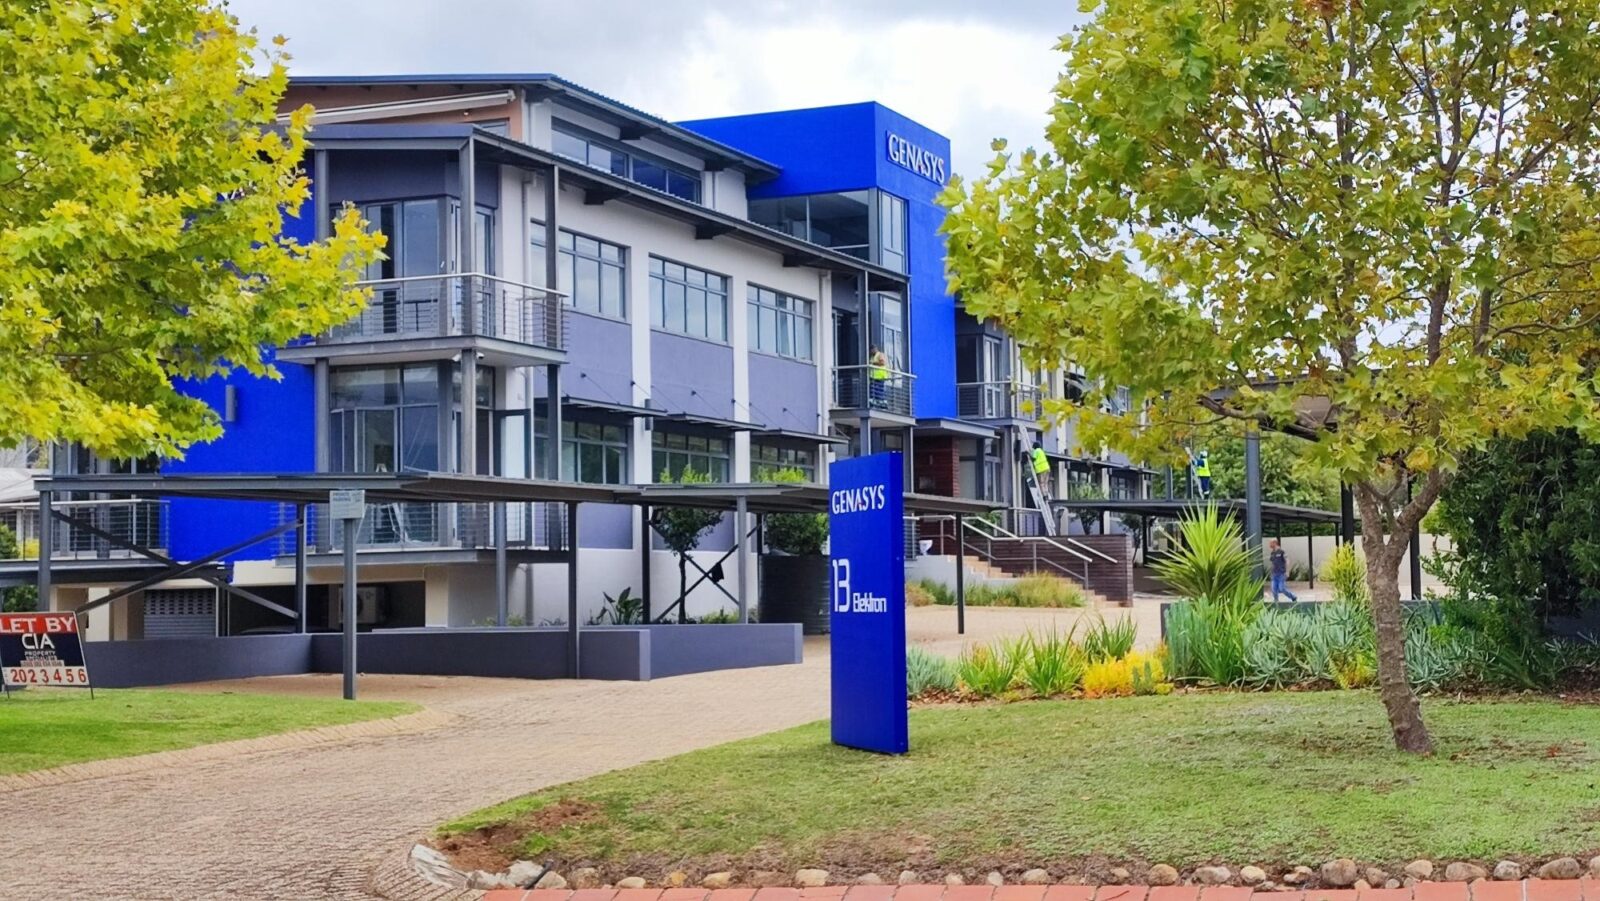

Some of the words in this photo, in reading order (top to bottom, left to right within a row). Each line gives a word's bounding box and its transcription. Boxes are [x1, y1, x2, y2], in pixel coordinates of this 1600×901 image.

[888, 133, 945, 184] GENASYS
[832, 484, 885, 514] GENASYS
[832, 558, 850, 612] 13
[852, 592, 887, 612] Elektron
[0, 617, 37, 633] LET
[44, 616, 74, 632] BY
[21, 633, 55, 649] CIA
